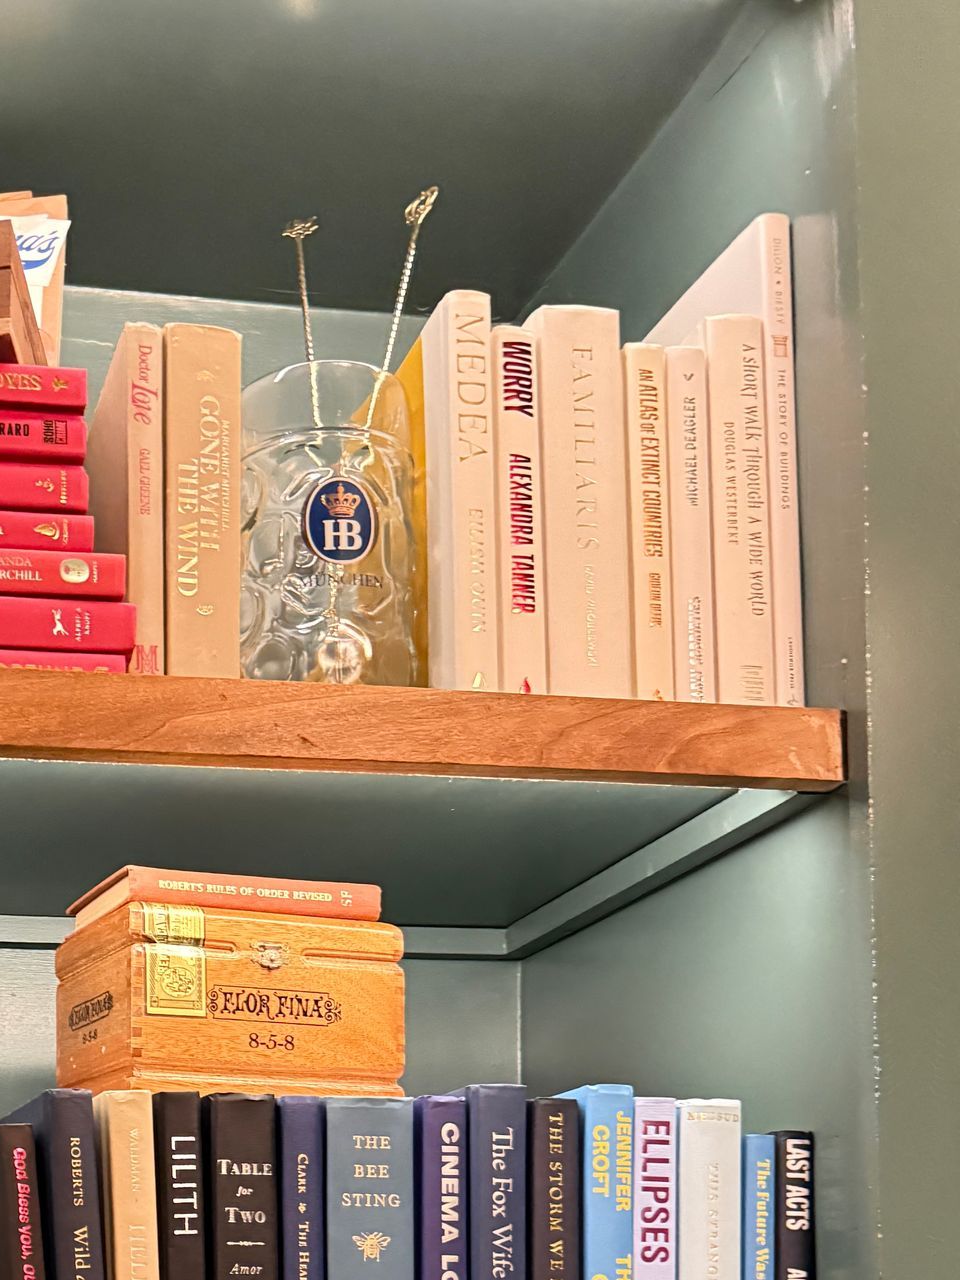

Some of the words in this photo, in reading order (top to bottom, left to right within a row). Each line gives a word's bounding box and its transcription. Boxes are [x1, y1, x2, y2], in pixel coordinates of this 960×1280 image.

[138, 344, 153, 382] Doctor
[502, 341, 534, 417] WORRY
[131, 380, 158, 426] Love
[639, 384, 659, 421] ATLAS
[43, 420, 54, 444] SOHO
[198, 395, 220, 474] GONE
[641, 436, 662, 486] EXTINCT
[139, 476, 151, 515] GREENE
[178, 458, 199, 514] THE
[509, 453, 533, 546] ALEXANDRA
[198, 482, 221, 551] WITH
[321, 519, 362, 551] HB
[643, 489, 664, 558] COUNTRIES
[177, 524, 199, 597] WIND
[511, 554, 537, 614] TANNER
[158, 879, 203, 893] ROBERT'S
[206, 883, 237, 894] RULES
[240, 886, 253, 896] OF
[256, 886, 290, 898] ORDER
[293, 890, 333, 902] REVISED
[220, 991, 272, 1020] FLOR
[277, 995, 325, 1019] FINA
[248, 1033, 295, 1051] 8-5-8
[353, 1135, 391, 1149] THE
[492, 1127, 514, 1170] The
[549, 1113, 564, 1154] THE
[71, 1137, 83, 1206] ROBERTS
[354, 1165, 390, 1178] BEE
[592, 1125, 608, 1197] CROFT
[615, 1110, 631, 1211] JENNIFER
[785, 1138, 809, 1181] LAST
[170, 1136, 198, 1235] LILITH
[236, 1186, 254, 1197] for
[342, 1193, 401, 1207] STING
[441, 1122, 460, 1244] CINEMA
[492, 1178, 513, 1217] Fox
[549, 1161, 564, 1232] STORM
[640, 1120, 671, 1263] ELLIPSES
[785, 1184, 809, 1231] ACTS
[73, 1226, 89, 1269] Wild
[492, 1224, 514, 1278] Wife
[549, 1240, 564, 1271] WE
[229, 1266, 263, 1275] Amor
